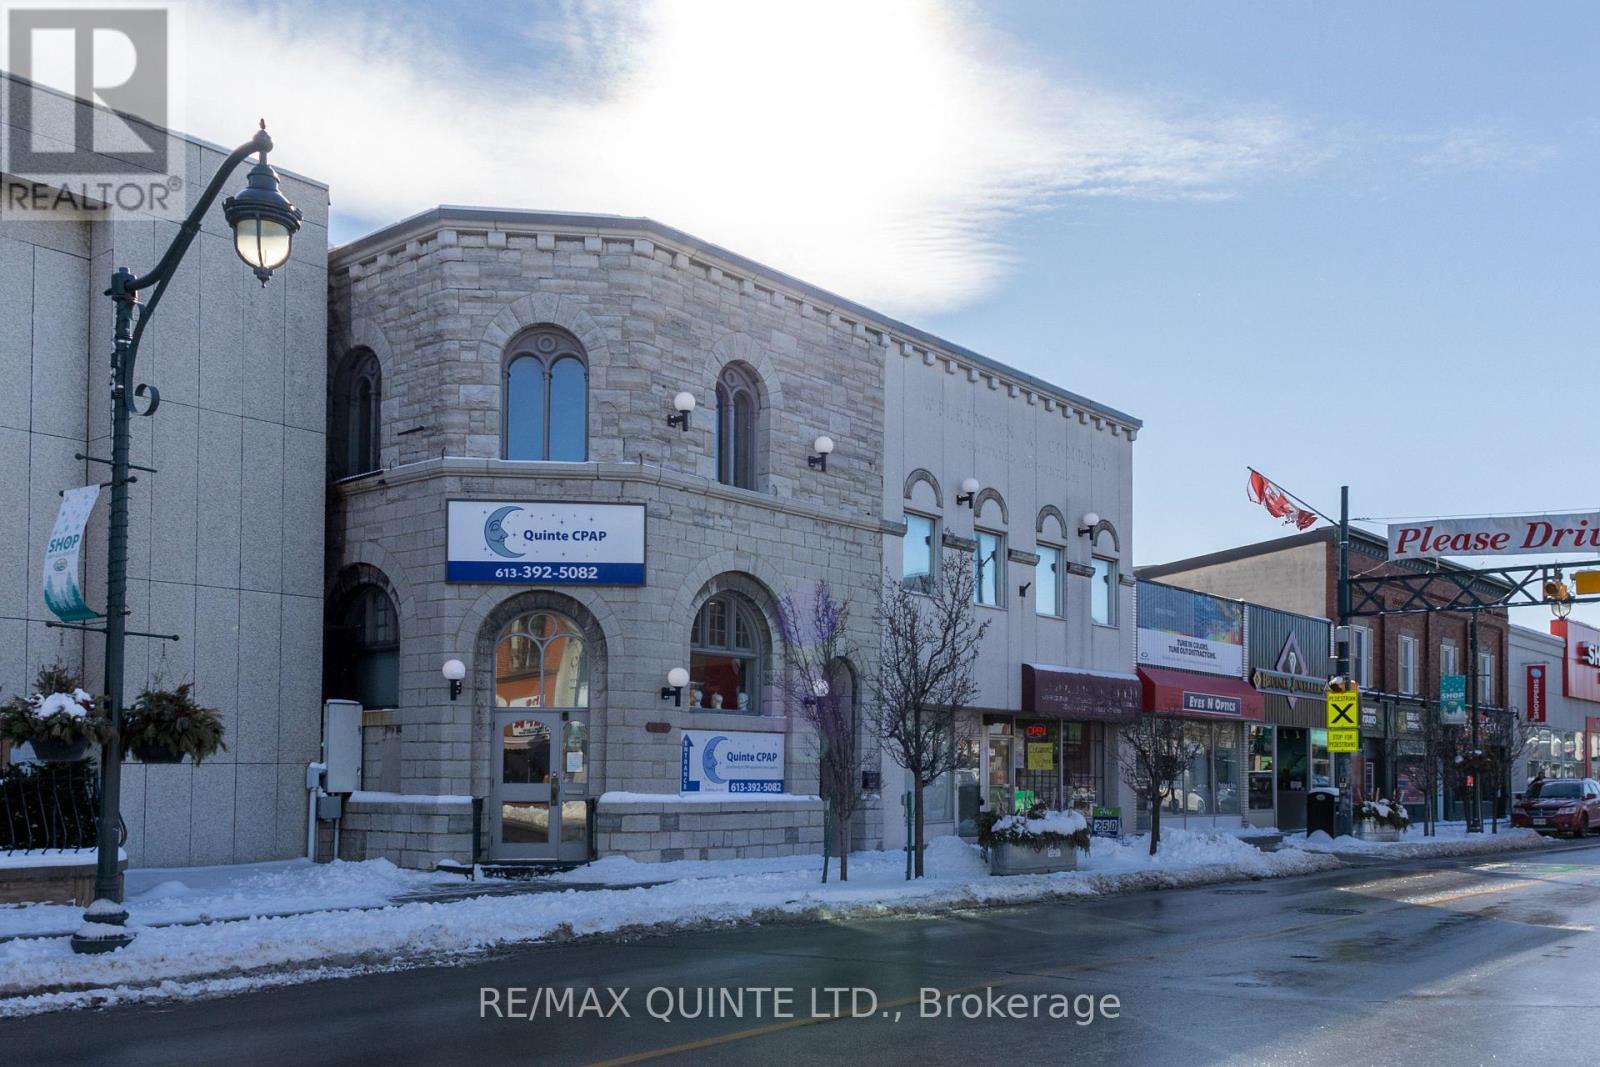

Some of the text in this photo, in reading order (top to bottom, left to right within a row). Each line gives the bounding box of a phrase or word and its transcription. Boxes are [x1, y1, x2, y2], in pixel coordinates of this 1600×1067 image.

[523, 530, 607, 542] Quinte CPAP
[1395, 525, 1511, 554] Please
[49, 534, 80, 553] SHOP
[495, 566, 598, 579] 613-392-5082
[1189, 695, 1236, 712] EYES N OPTICS
[1027, 725, 1046, 736] OPEN
[727, 751, 778, 762] Quinte CPAP
[730, 782, 782, 792] 613-392-5082
